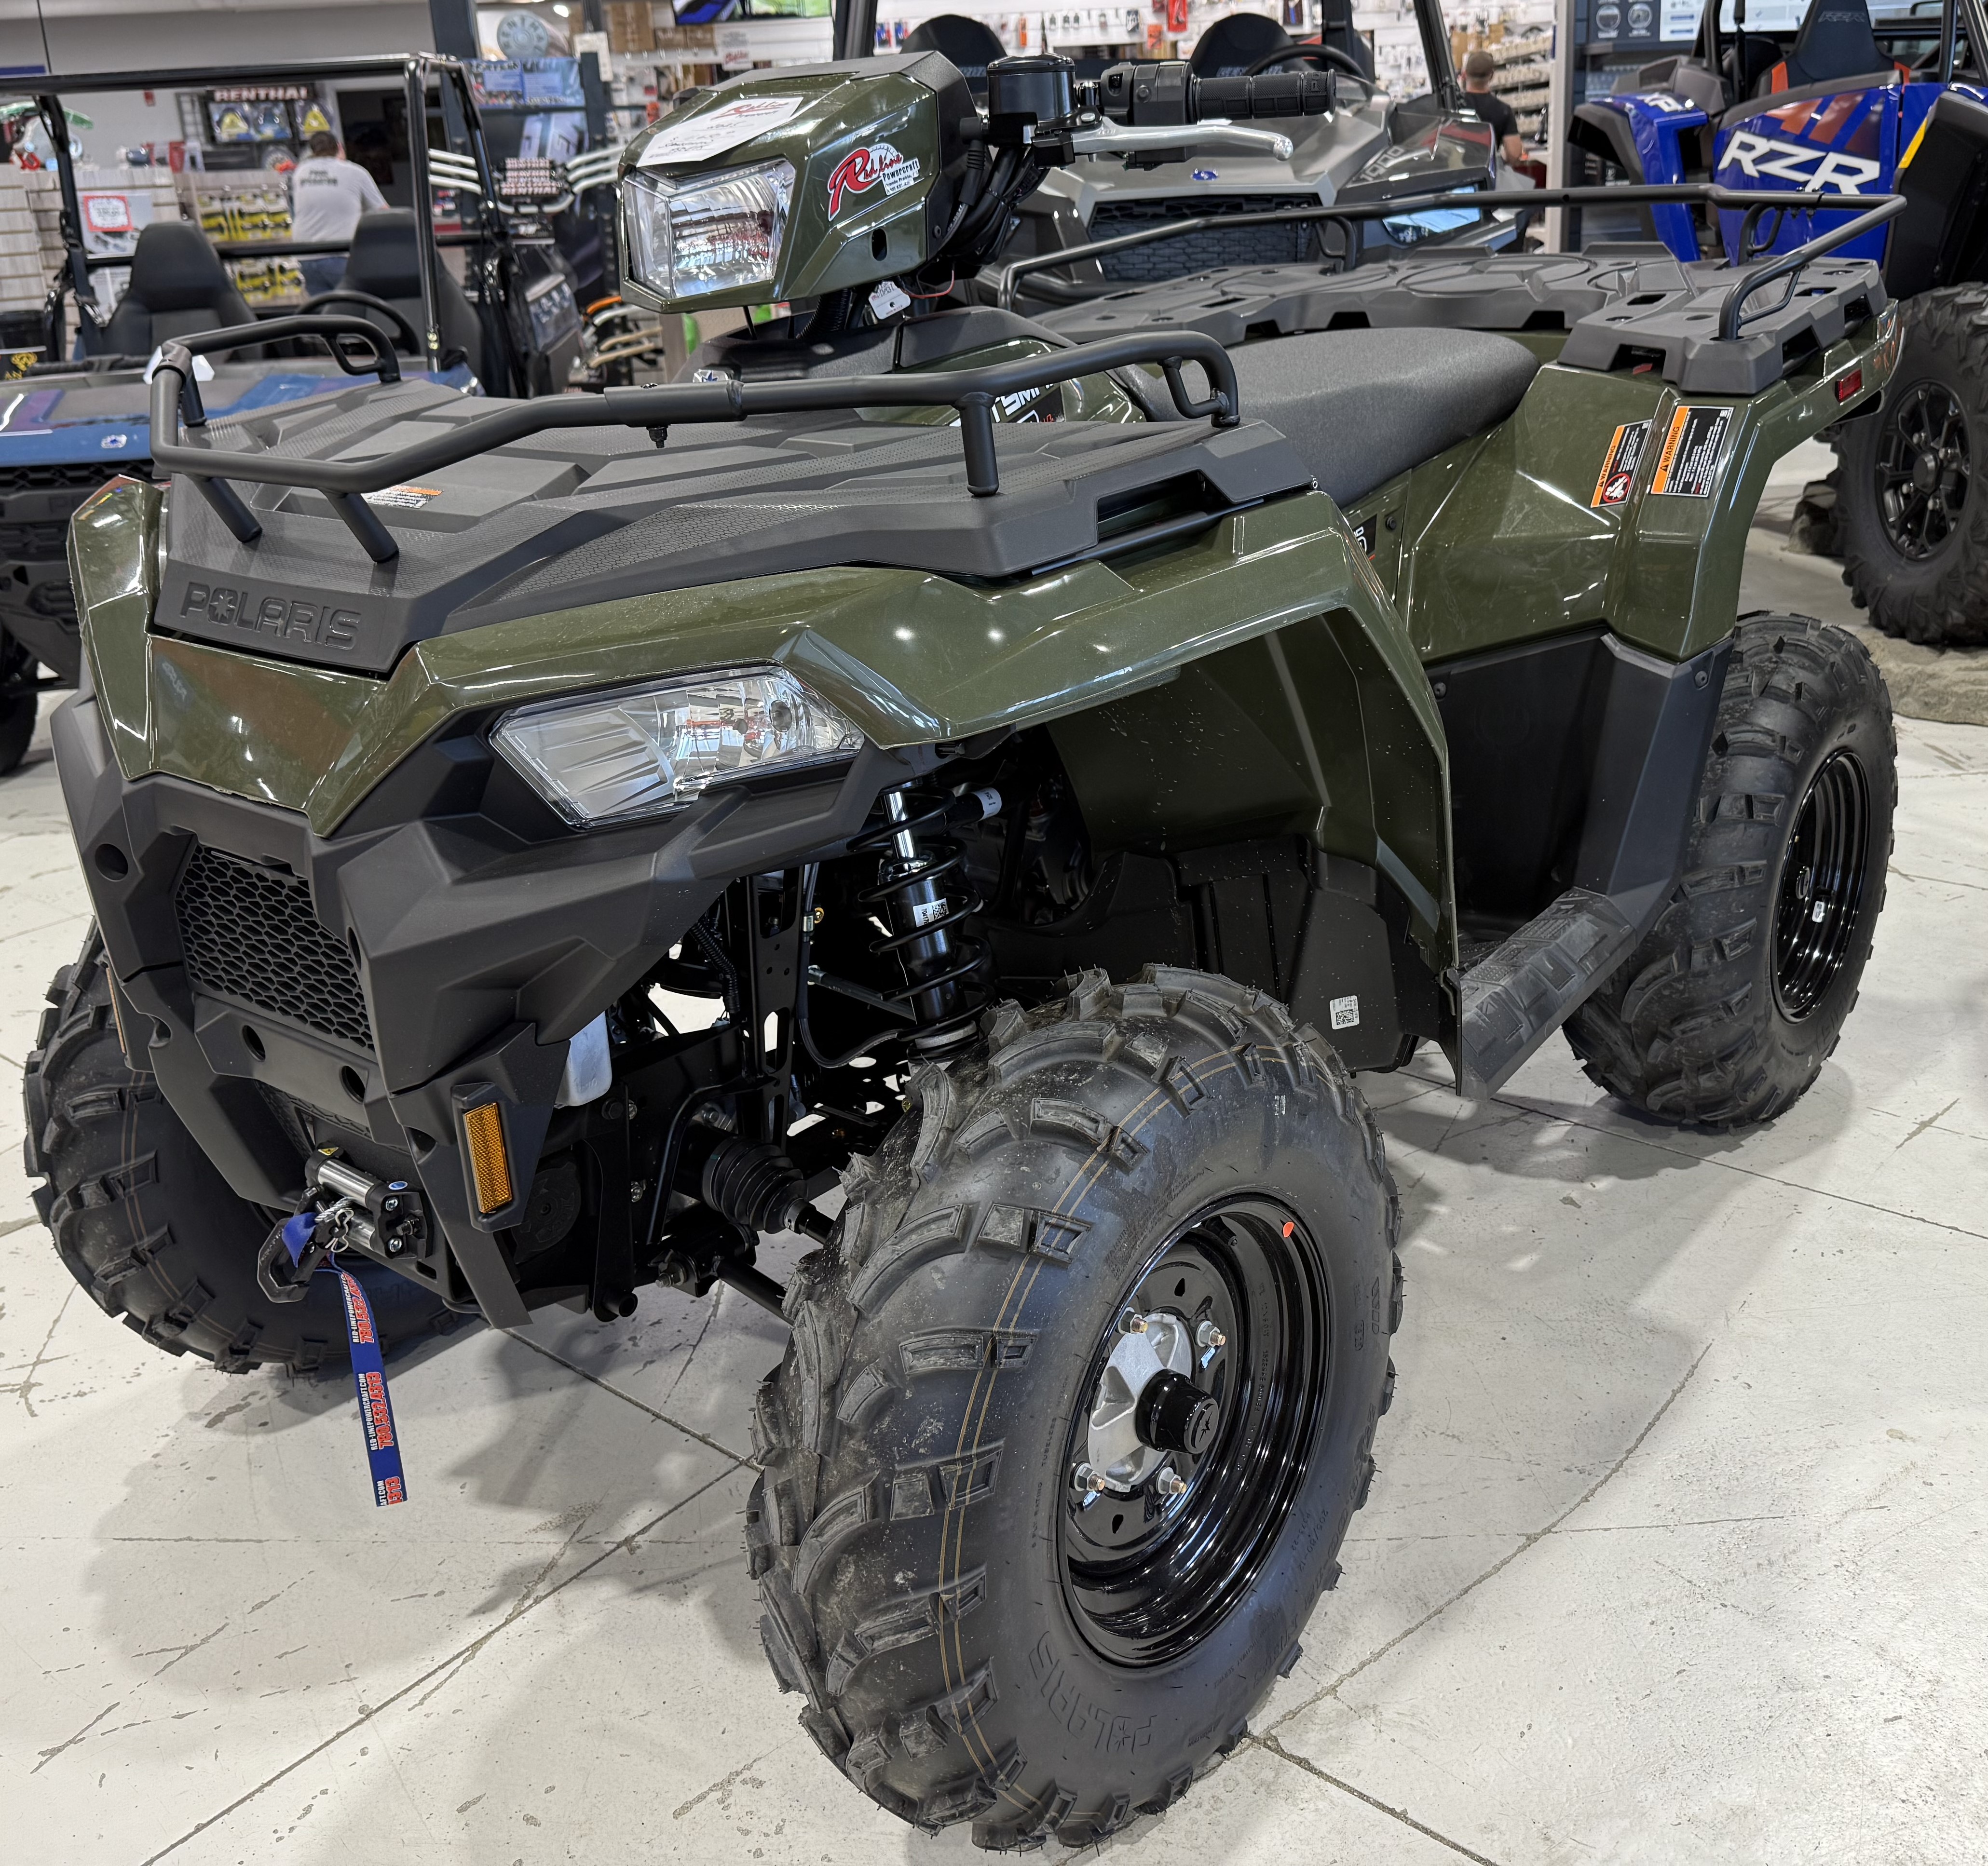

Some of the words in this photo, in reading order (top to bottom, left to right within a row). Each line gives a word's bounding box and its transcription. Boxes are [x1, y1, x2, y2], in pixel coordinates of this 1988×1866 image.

[1718, 130, 1880, 194] RZR
[1601, 445, 1616, 481] WARNING
[1663, 426, 1680, 466] WARNING
[179, 581, 361, 650] POLARIS
[1028, 1631, 1157, 1755] POLARIS
